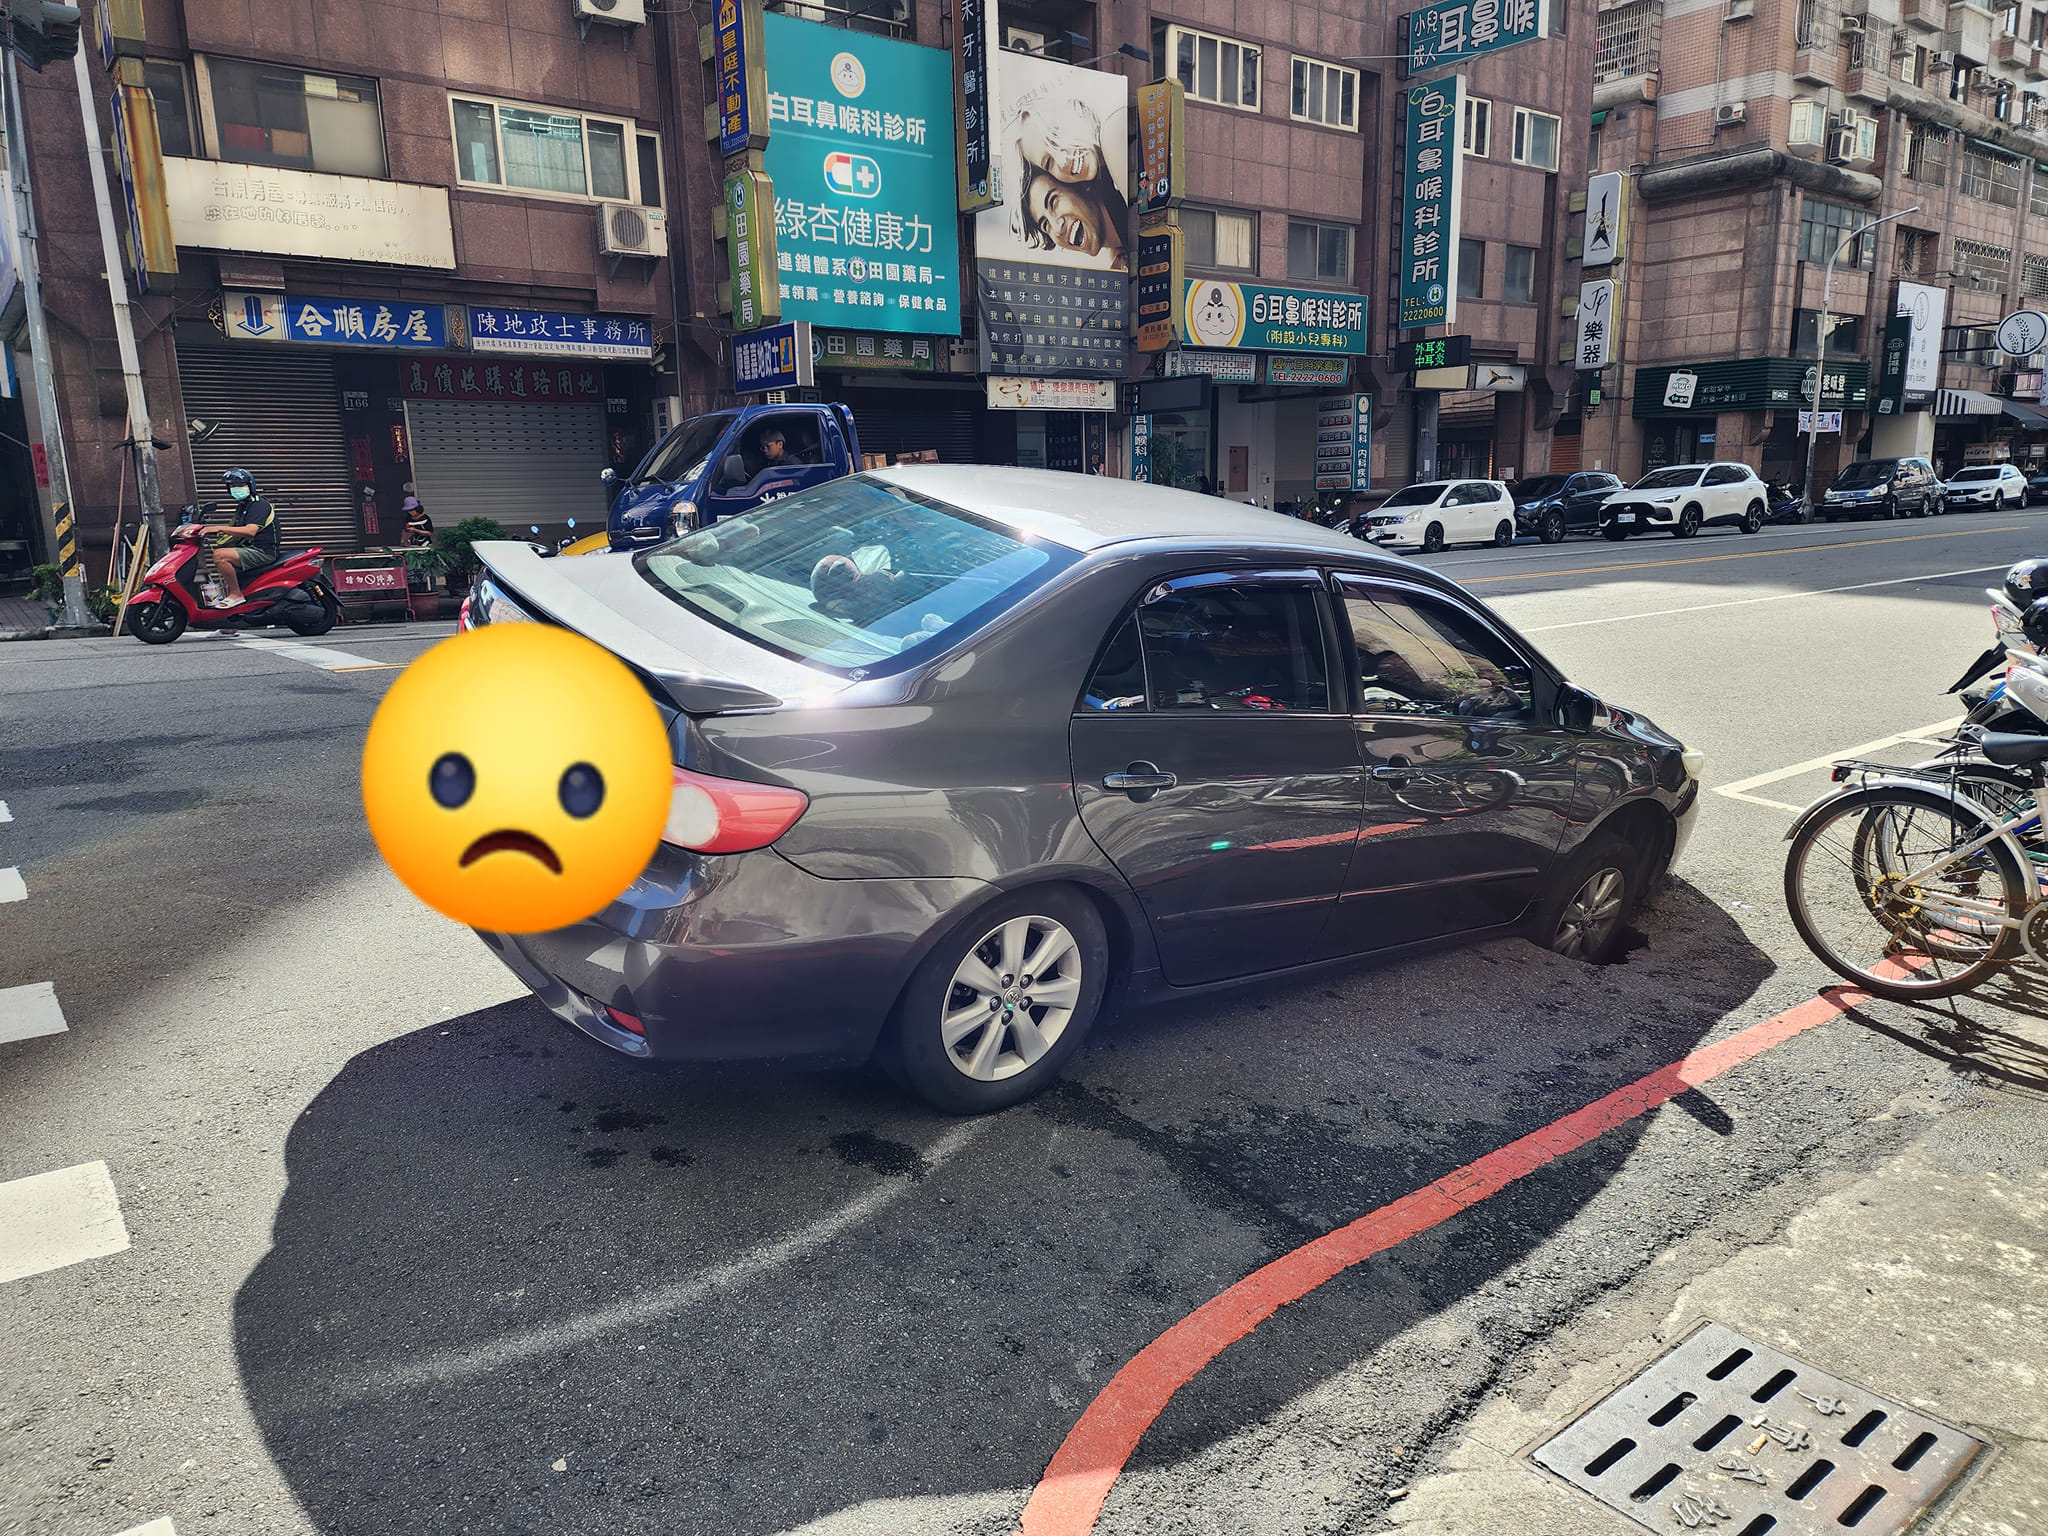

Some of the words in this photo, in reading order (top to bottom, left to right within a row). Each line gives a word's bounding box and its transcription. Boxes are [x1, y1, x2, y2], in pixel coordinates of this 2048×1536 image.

[1414, 9, 1438, 37] 小兒
[1438, 0, 1536, 53] 耳鼻喉
[1413, 42, 1437, 69] 成人
[722, 30, 743, 135] 皇庭不動產
[767, 91, 927, 145] 白耳鼻喉科診所
[1411, 90, 1446, 284] 白耳鼻喉科診所
[774, 196, 933, 253] 綠杏健康力
[735, 210, 754, 325] 田園藥局
[777, 251, 848, 277] 連鎖體系
[833, 288, 885, 307] 營養諮詢
[898, 294, 948, 312] 保健食品
[1252, 293, 1364, 332] 白耳鼻喉科診所
[1403, 305, 1444, 323] 22220600
[1404, 296, 1427, 308] TEL:
[295, 303, 433, 342] 合順房屋
[477, 311, 646, 343] 陳地政士事務所
[827, 335, 931, 360] 田園藥局
[1265, 329, 1348, 348] (附設小兒專科)
[1415, 341, 1446, 355] 外耳炎
[1583, 320, 1603, 364] 樂器
[1415, 353, 1446, 367] 中耳炎
[408, 360, 599, 398] 高價收購道路用地
[1272, 371, 1343, 384] TEL:2222-0600
[349, 398, 369, 408] 166
